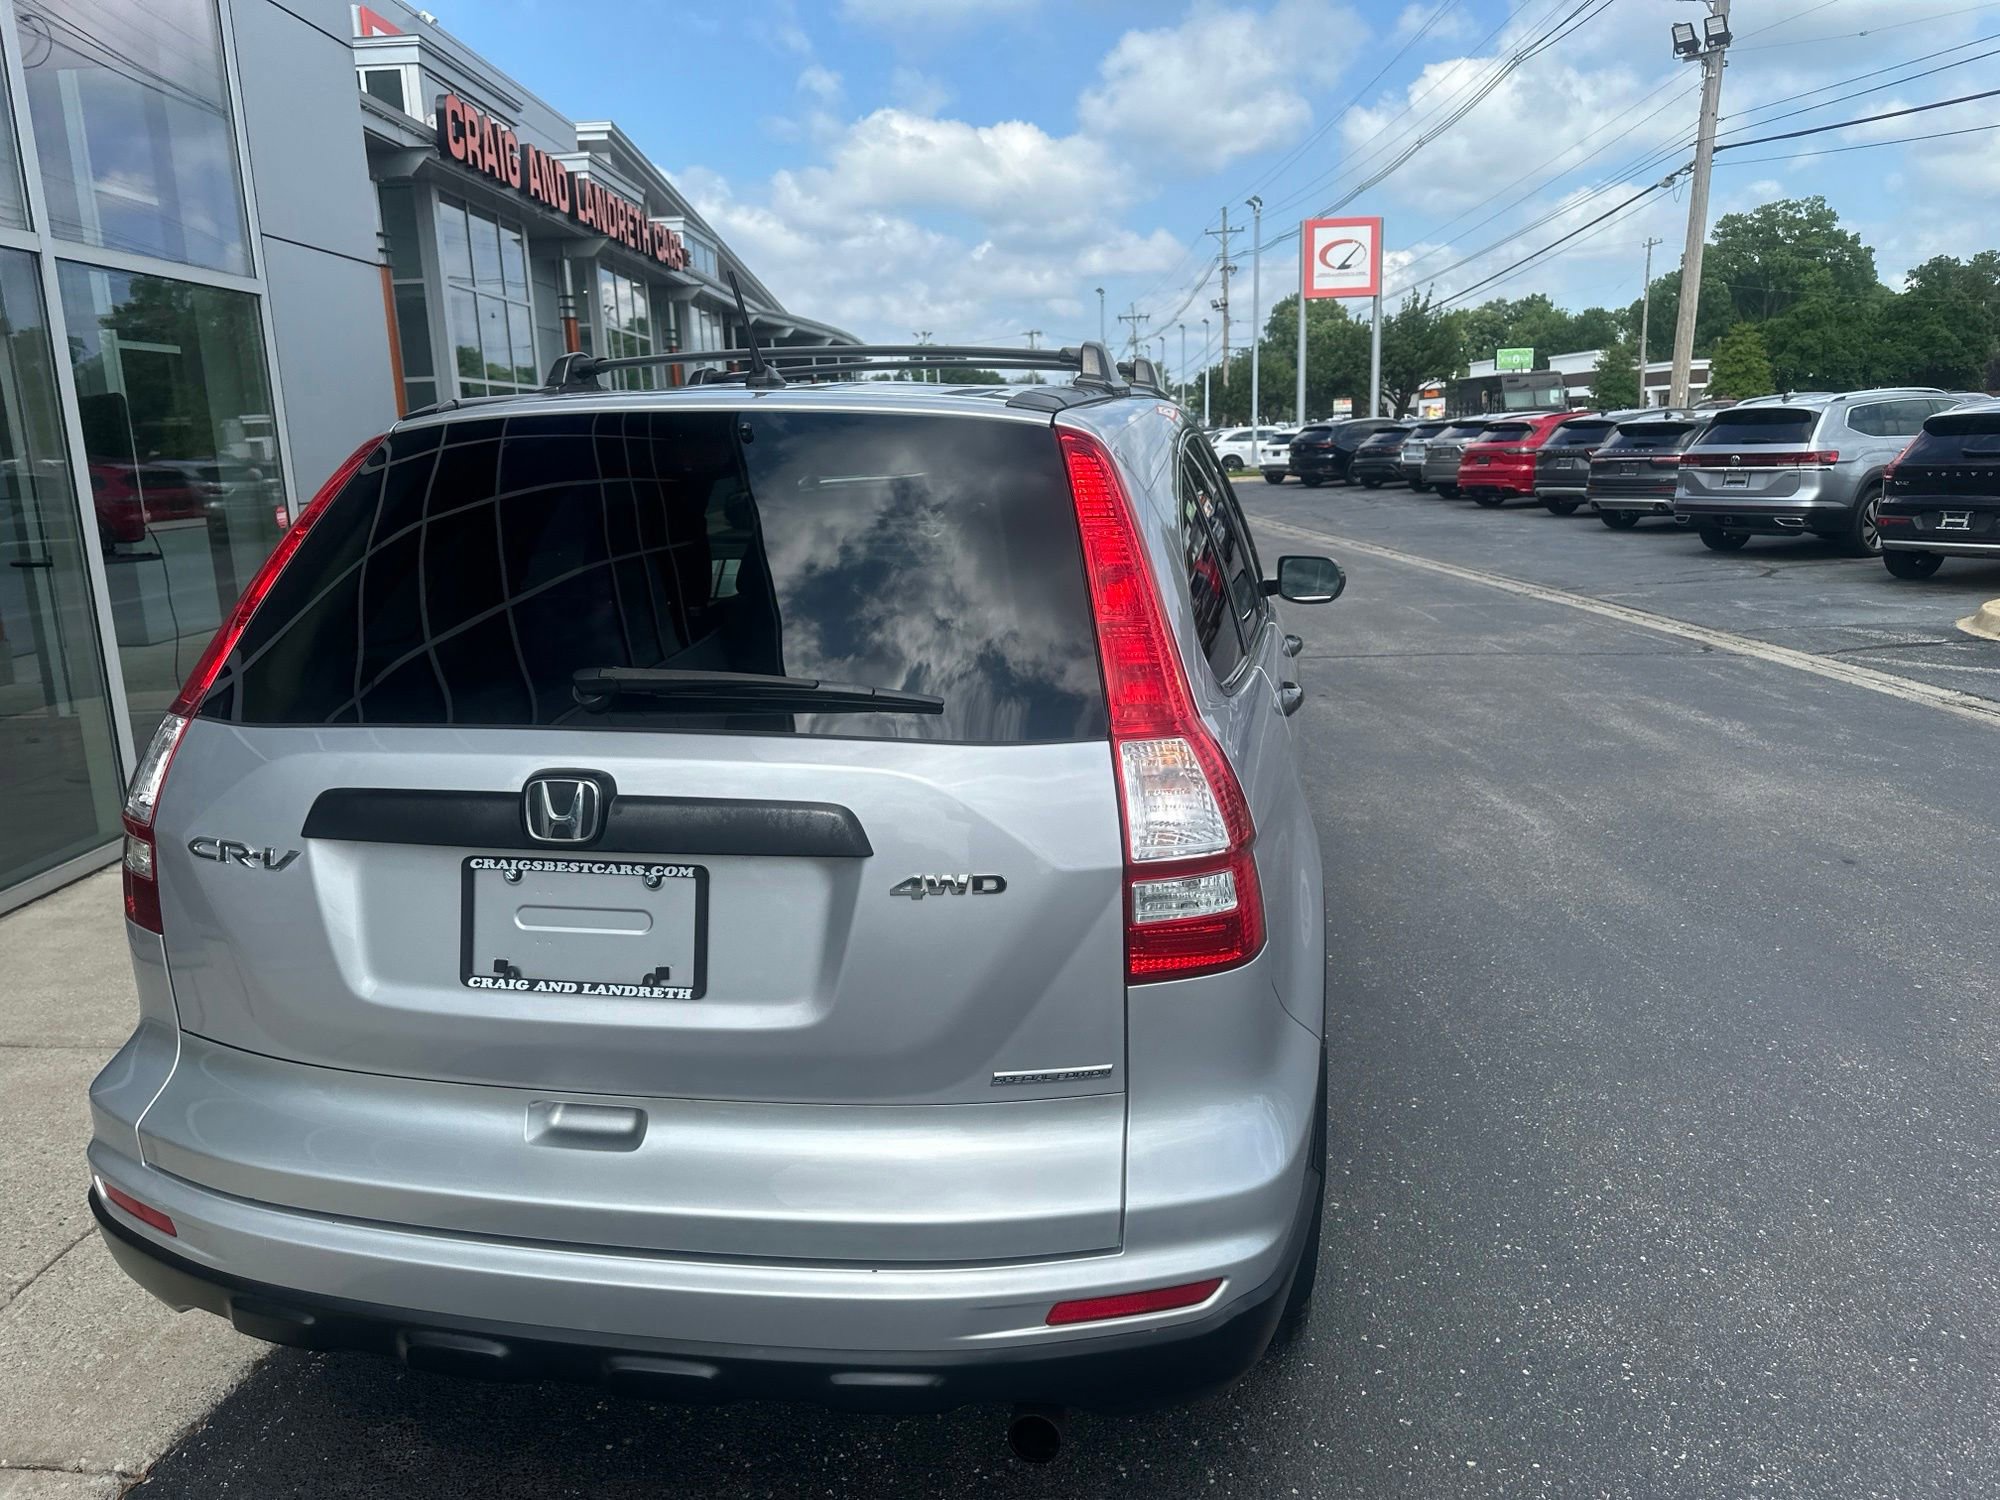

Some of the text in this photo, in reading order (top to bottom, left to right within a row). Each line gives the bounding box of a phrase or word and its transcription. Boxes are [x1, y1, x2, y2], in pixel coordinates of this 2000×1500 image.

[445, 93, 684, 271] CRAIG AND LANDRETH CARS
[187, 836, 301, 872] CR-V
[469, 858, 695, 878] CRAIGSBESTCARS.COM
[890, 873, 1008, 900] 4WD
[467, 977, 693, 1000] CRAIG AND LANDRETH
